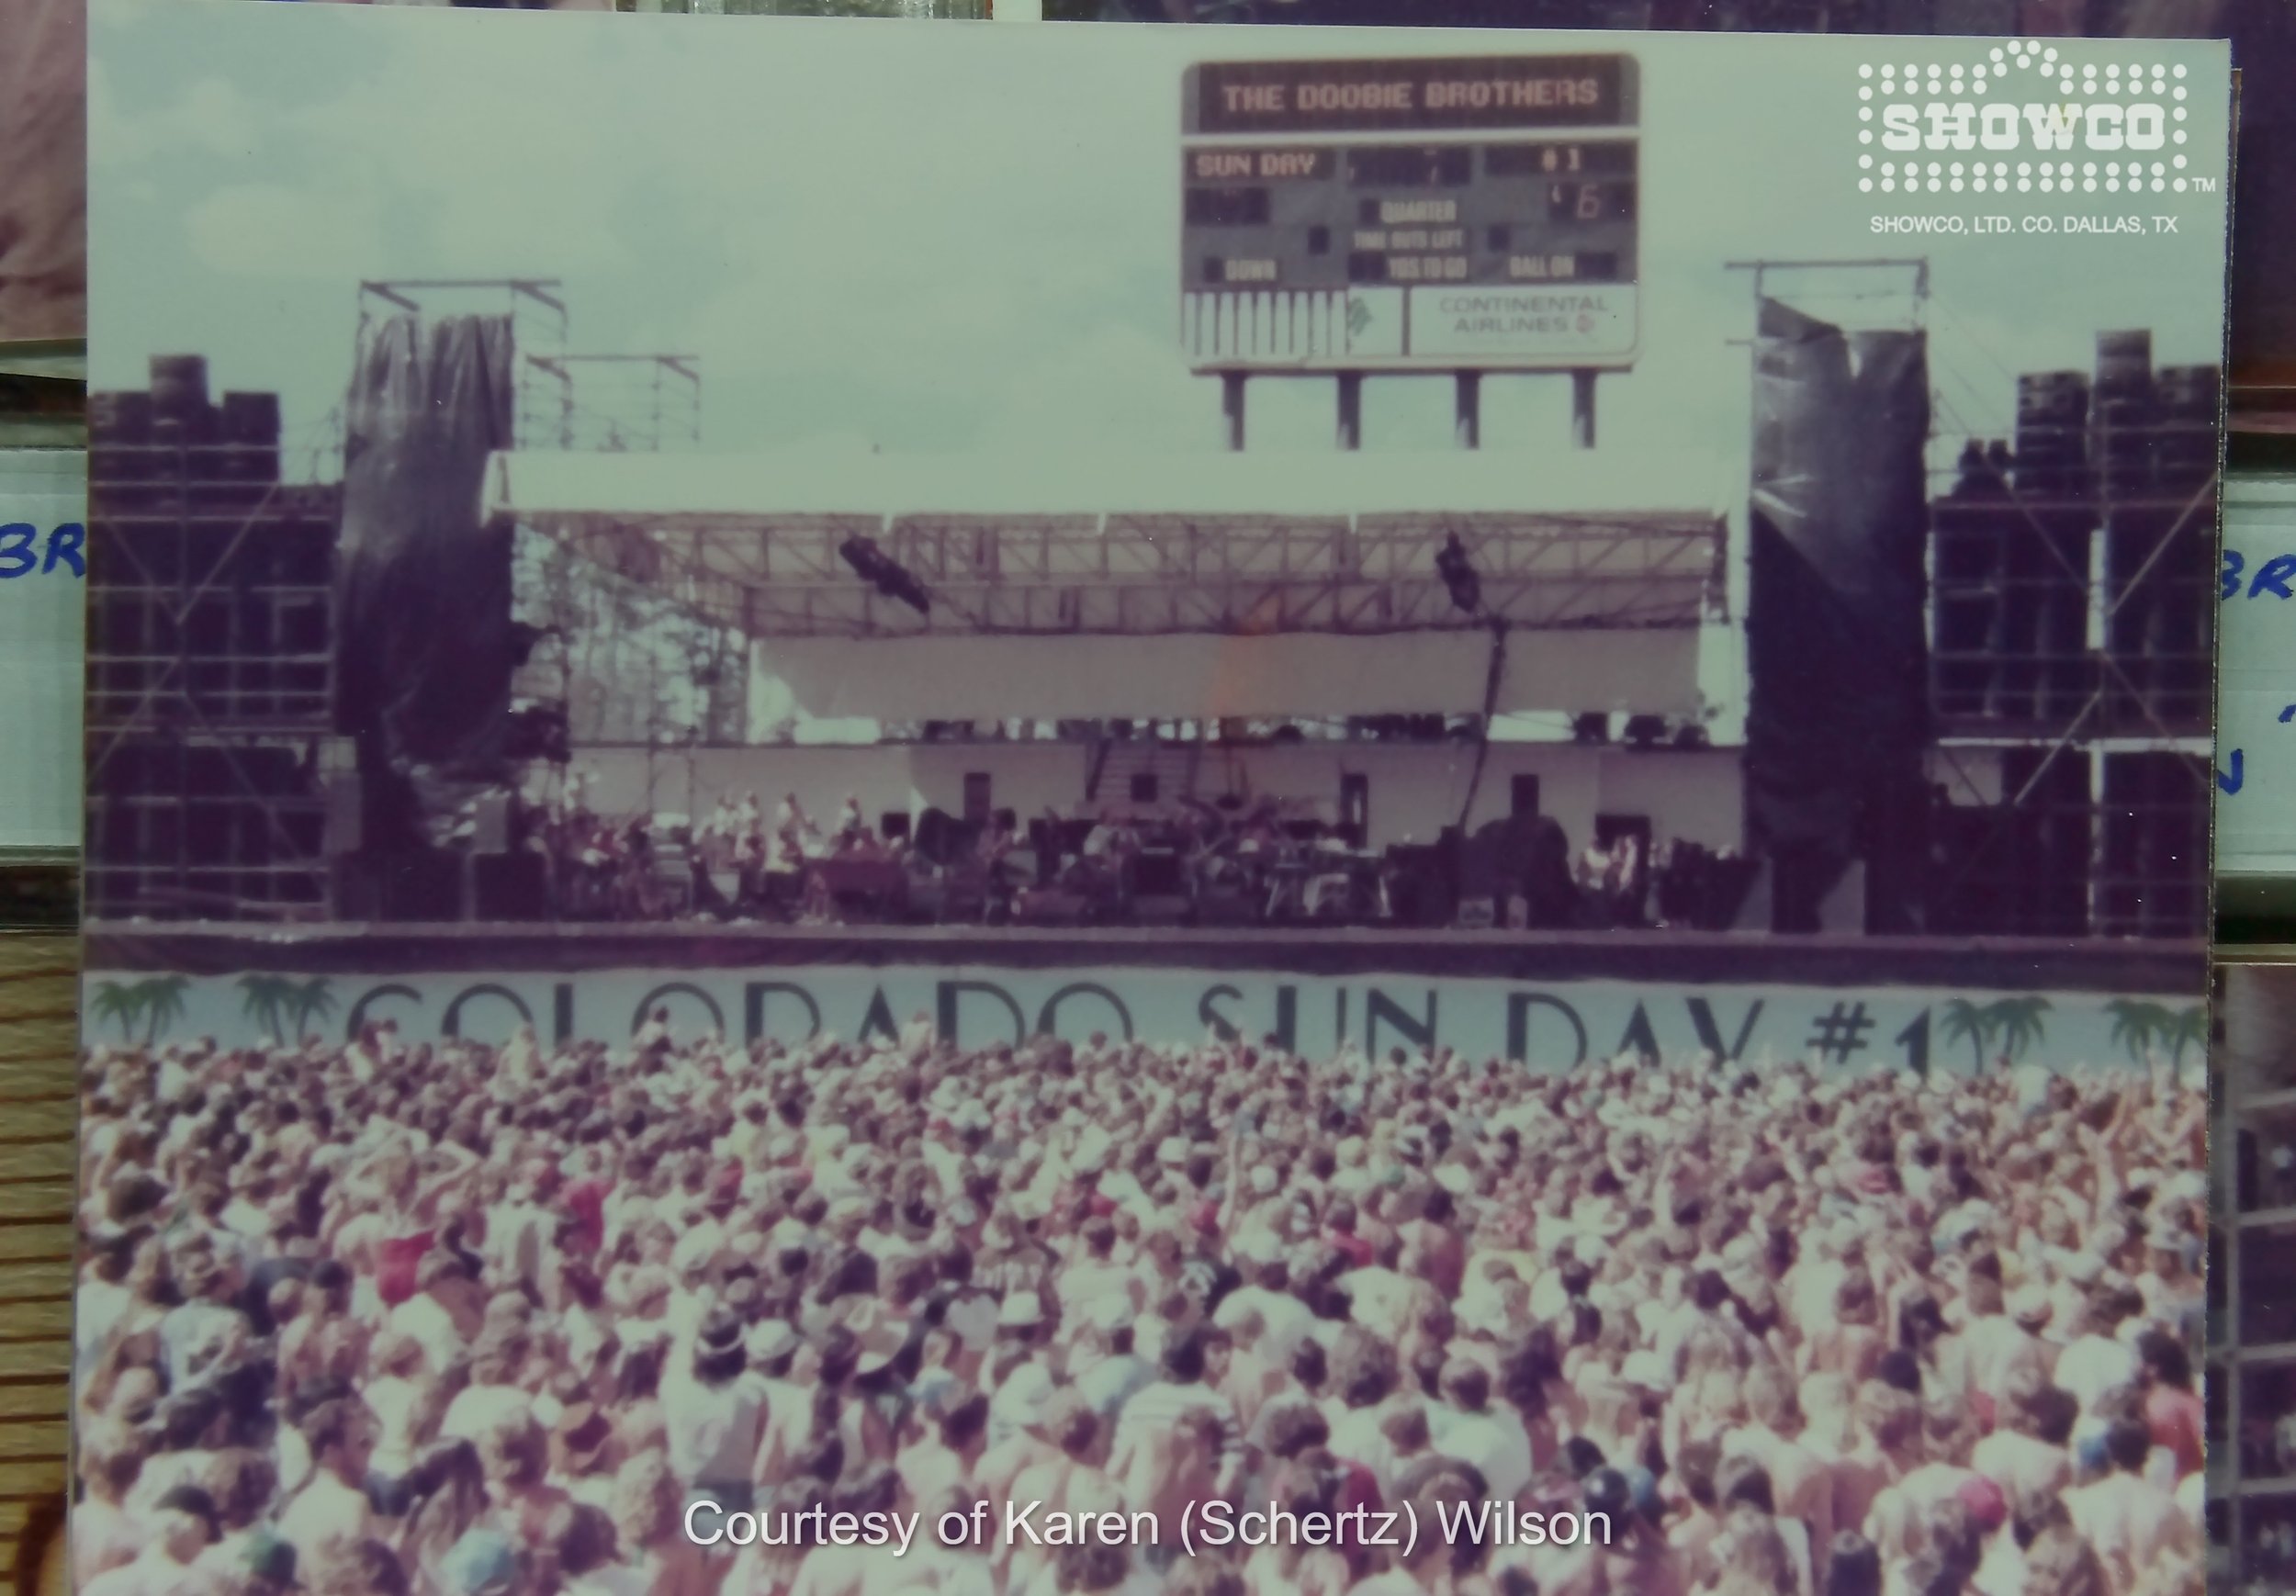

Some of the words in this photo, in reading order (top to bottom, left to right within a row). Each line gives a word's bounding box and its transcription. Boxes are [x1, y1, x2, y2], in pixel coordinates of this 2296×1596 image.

[1222, 84, 1284, 111] THE
[1297, 82, 1413, 110] DOOBIE
[1425, 78, 1599, 108] BROTHERS
[1196, 153, 1252, 176] SUN
[1260, 152, 1315, 175] DAY
[1439, 295, 1608, 314] CONTINENTAL
[1454, 316, 1569, 333] AIRLINES
